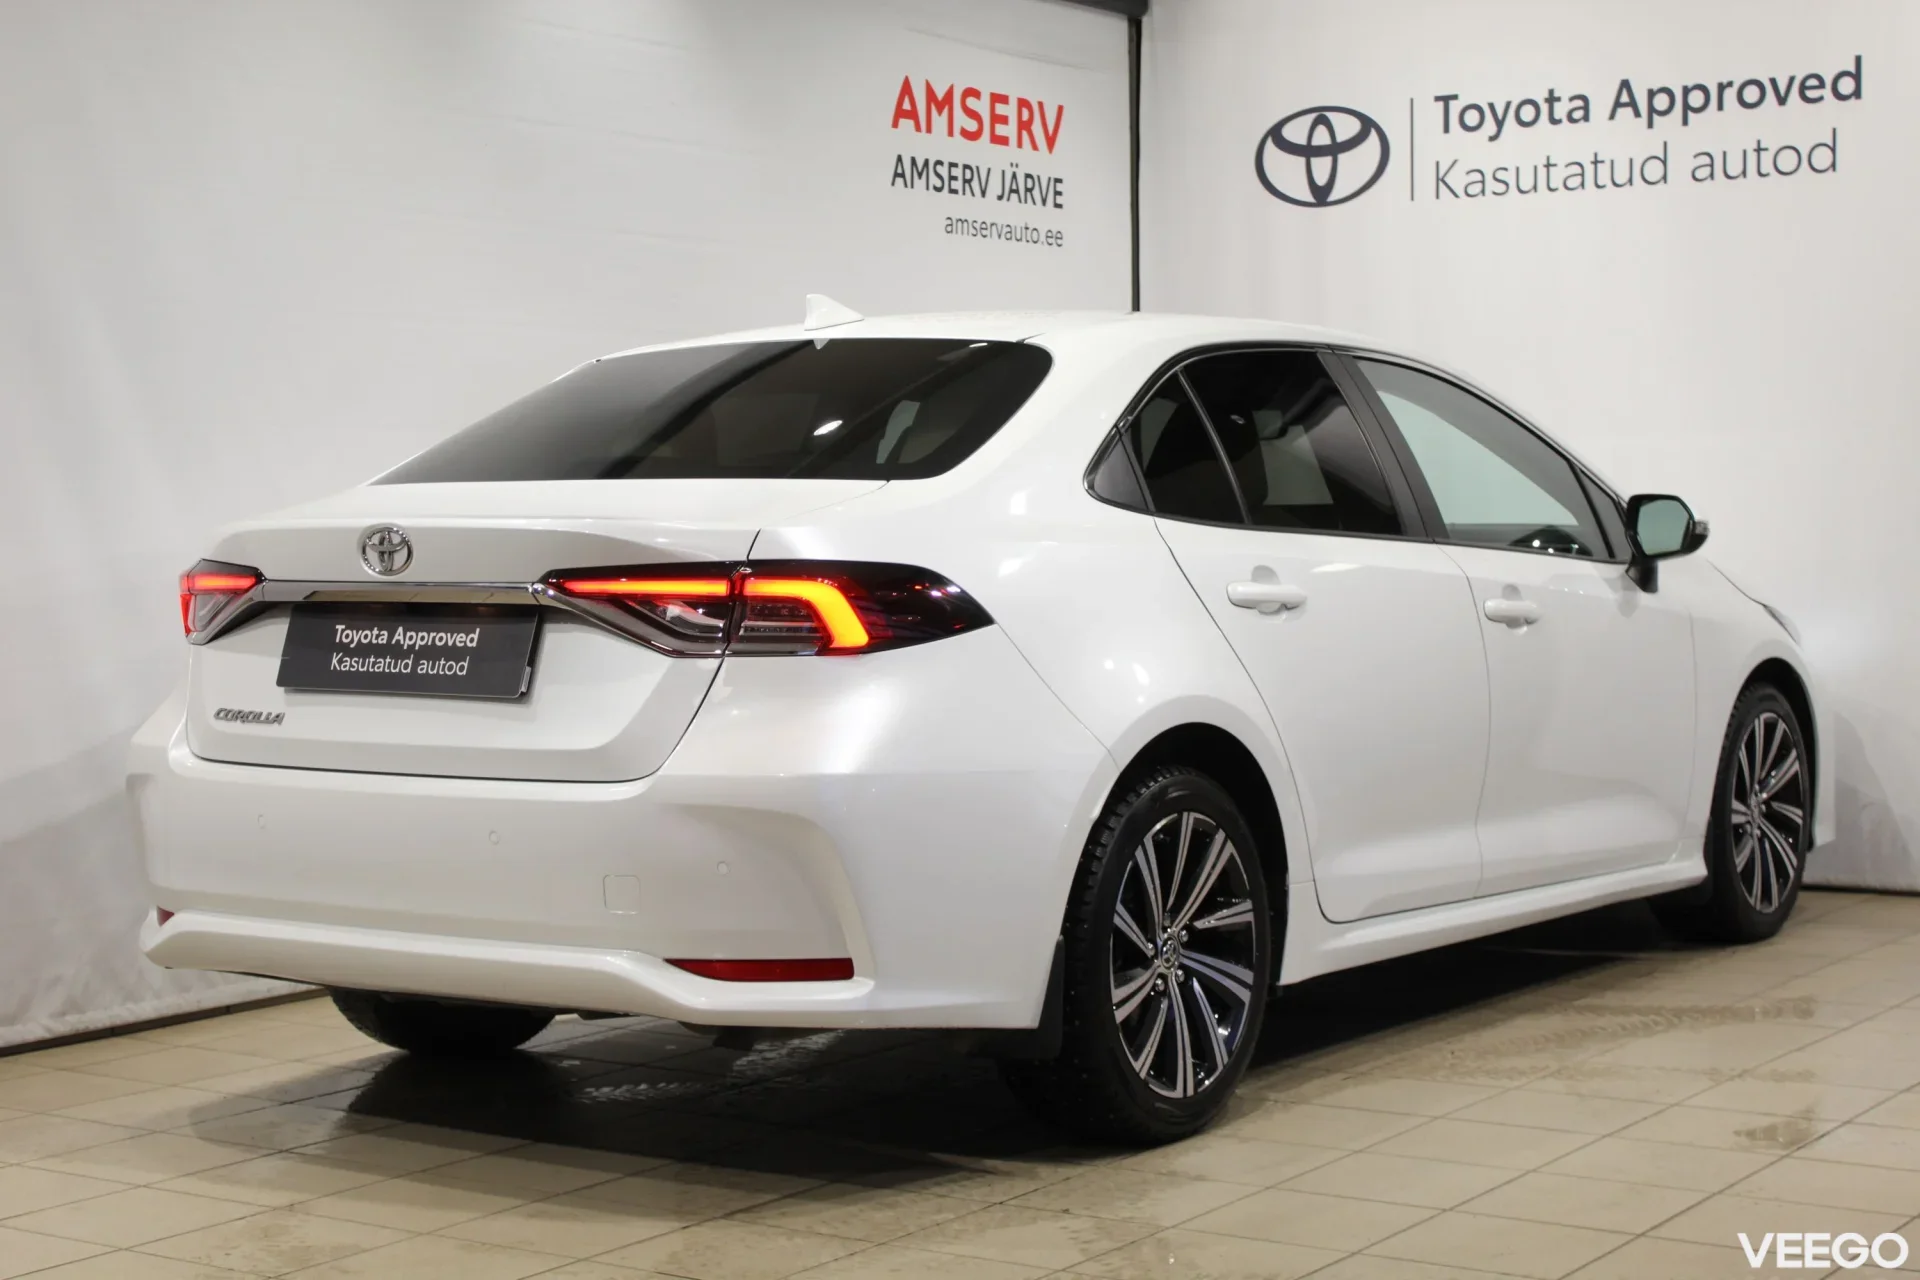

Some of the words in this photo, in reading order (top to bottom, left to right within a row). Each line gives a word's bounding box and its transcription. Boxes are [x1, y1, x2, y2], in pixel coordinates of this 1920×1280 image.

[891, 75, 1064, 154] AMSERV
[1434, 88, 1591, 142] Toyota
[1608, 55, 1863, 128] Approved
[891, 154, 991, 198] AMSERV
[996, 162, 1064, 209] JÄRVE
[1434, 141, 1668, 200] Kasutatud
[1690, 128, 1838, 182] autod
[944, 216, 1064, 247] amservauto.ee
[334, 624, 388, 649] Toyota
[392, 625, 479, 650] Approved
[330, 653, 413, 675] Kasutatud
[417, 655, 469, 677] autod
[214, 707, 285, 726] COROLLA
